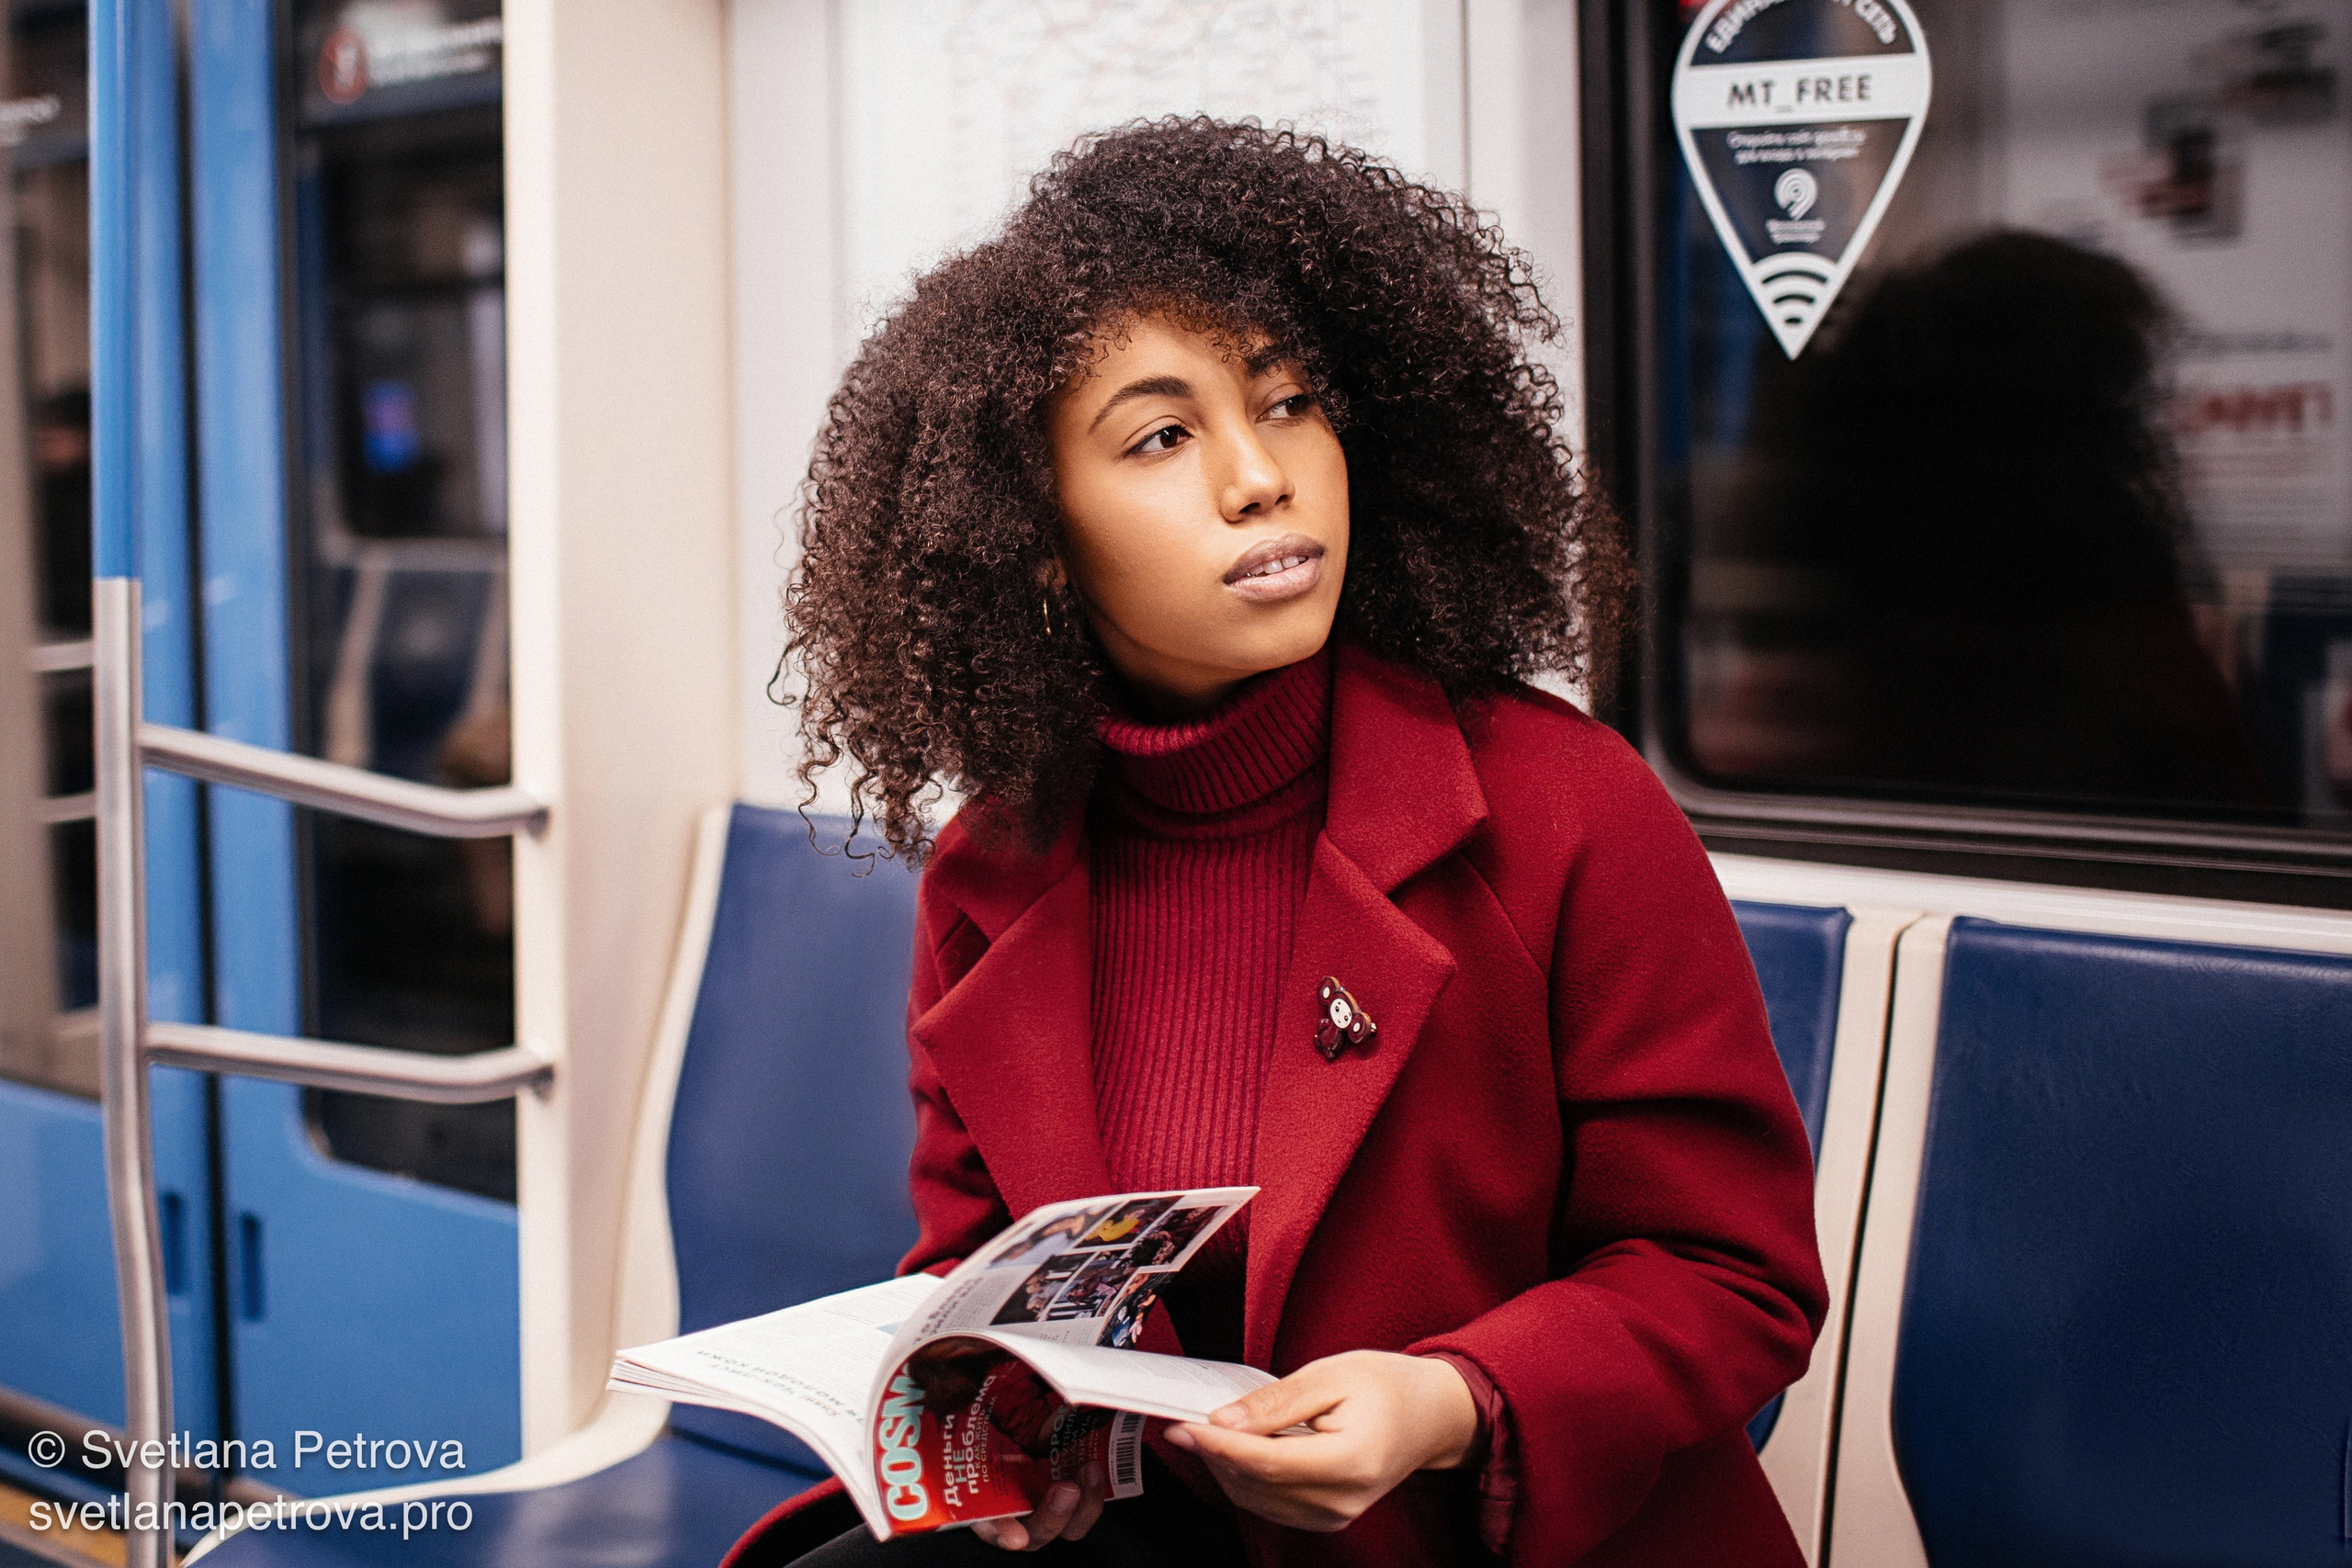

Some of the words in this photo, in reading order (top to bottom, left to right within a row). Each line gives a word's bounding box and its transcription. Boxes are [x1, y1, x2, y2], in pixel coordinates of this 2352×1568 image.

[1727, 74, 1873, 113] MT_FREE
[879, 1363, 928, 1521] COSM
[962, 1375, 997, 1494] проблема
[975, 1409, 986, 1441] ЖИТЬ
[944, 1415, 963, 1506] Деньги
[953, 1450, 967, 1483] НЕ
[981, 1465, 989, 1483] ПО
